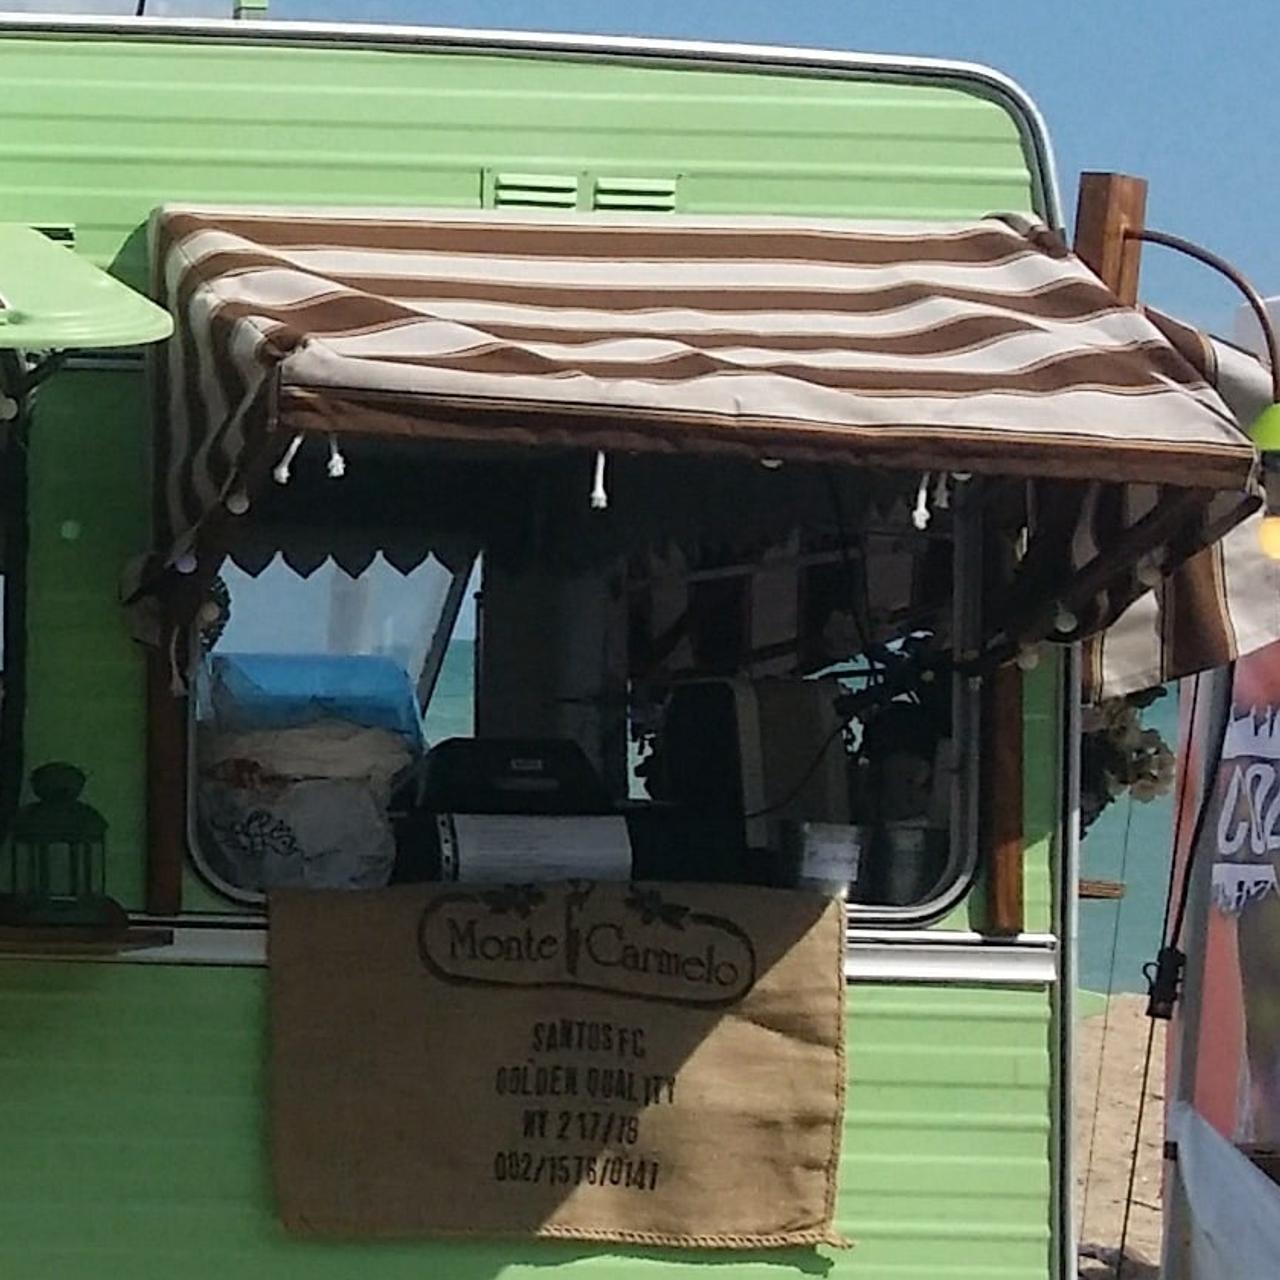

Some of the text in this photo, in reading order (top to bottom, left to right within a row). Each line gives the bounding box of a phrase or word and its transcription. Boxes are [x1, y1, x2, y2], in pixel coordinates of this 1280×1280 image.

[447, 918, 739, 987] Monte Carmelo
[532, 1019, 647, 1058] SANTOS FC
